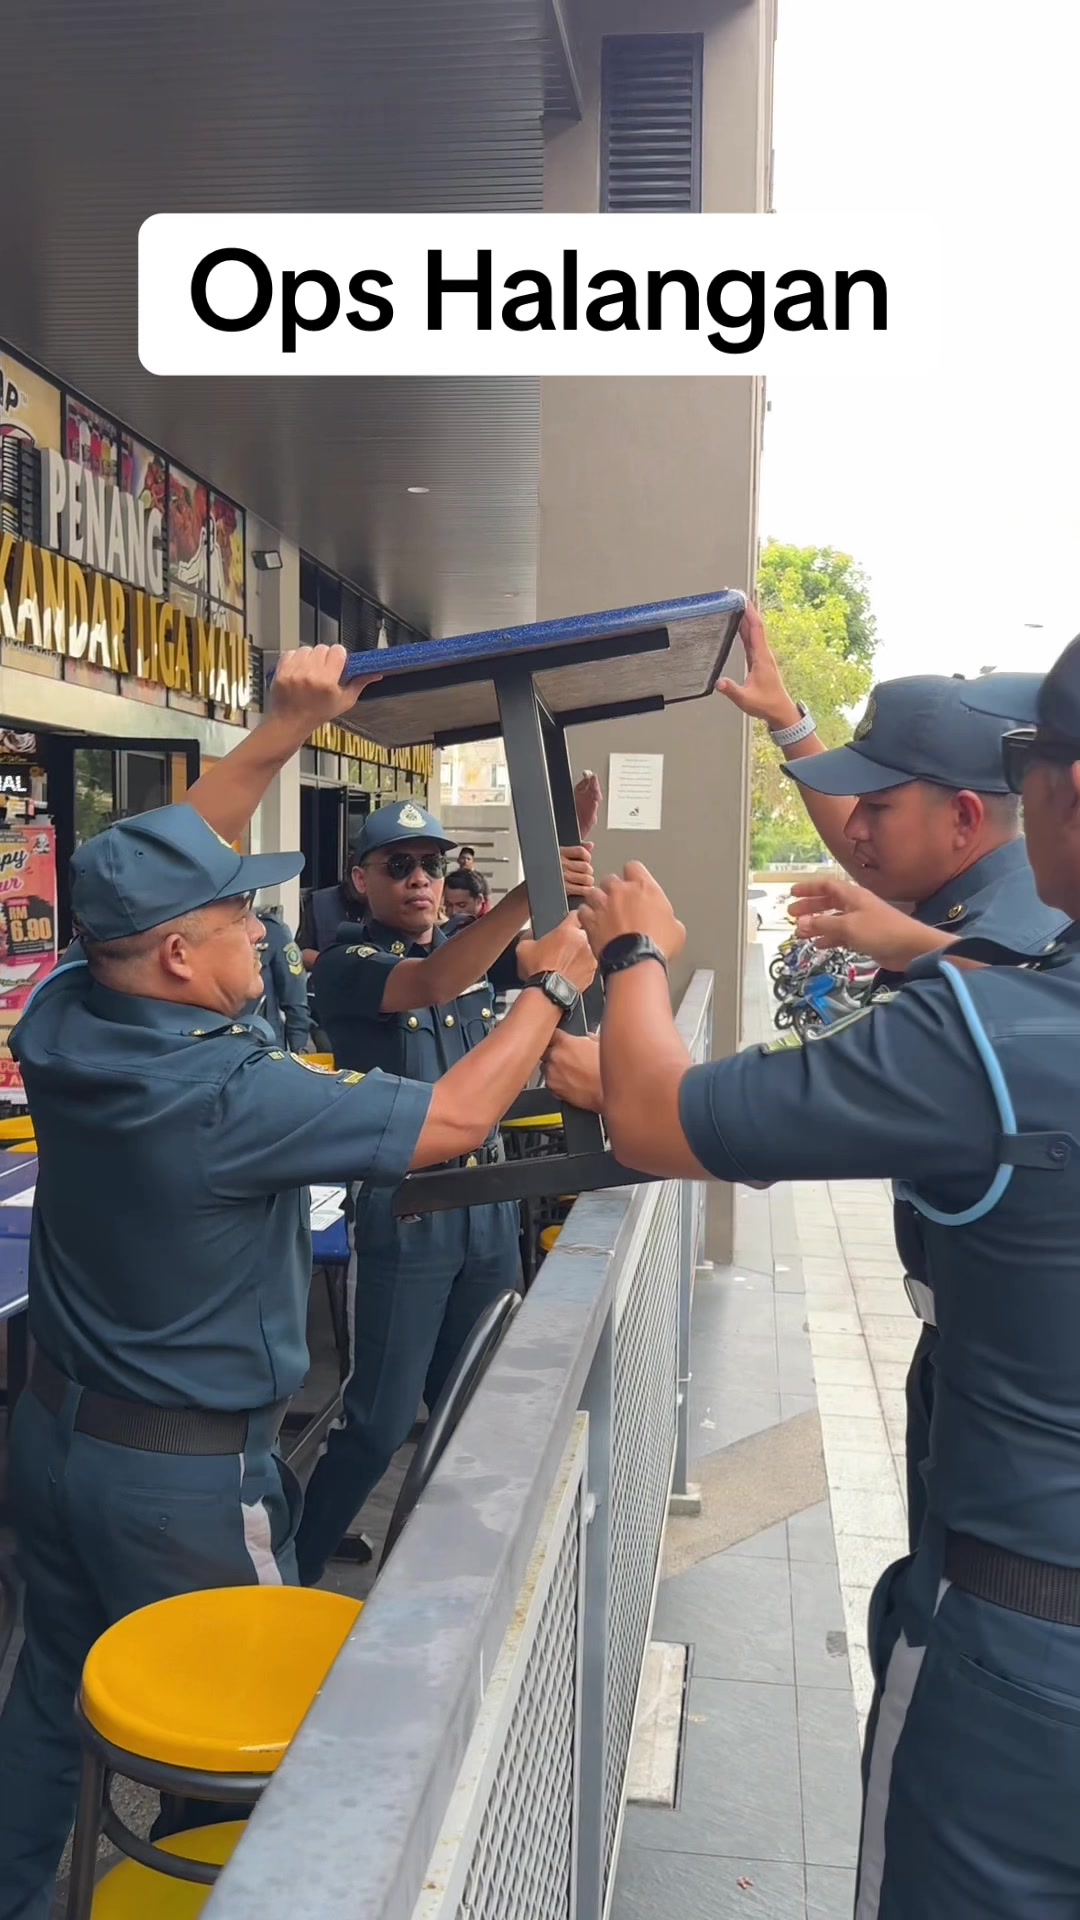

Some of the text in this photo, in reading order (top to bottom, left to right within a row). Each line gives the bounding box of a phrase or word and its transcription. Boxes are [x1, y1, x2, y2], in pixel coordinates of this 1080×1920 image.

[46, 447, 164, 597] PENANG
[0, 531, 250, 721] KANDAR LIGA MAJU
[9, 906, 28, 920] RM
